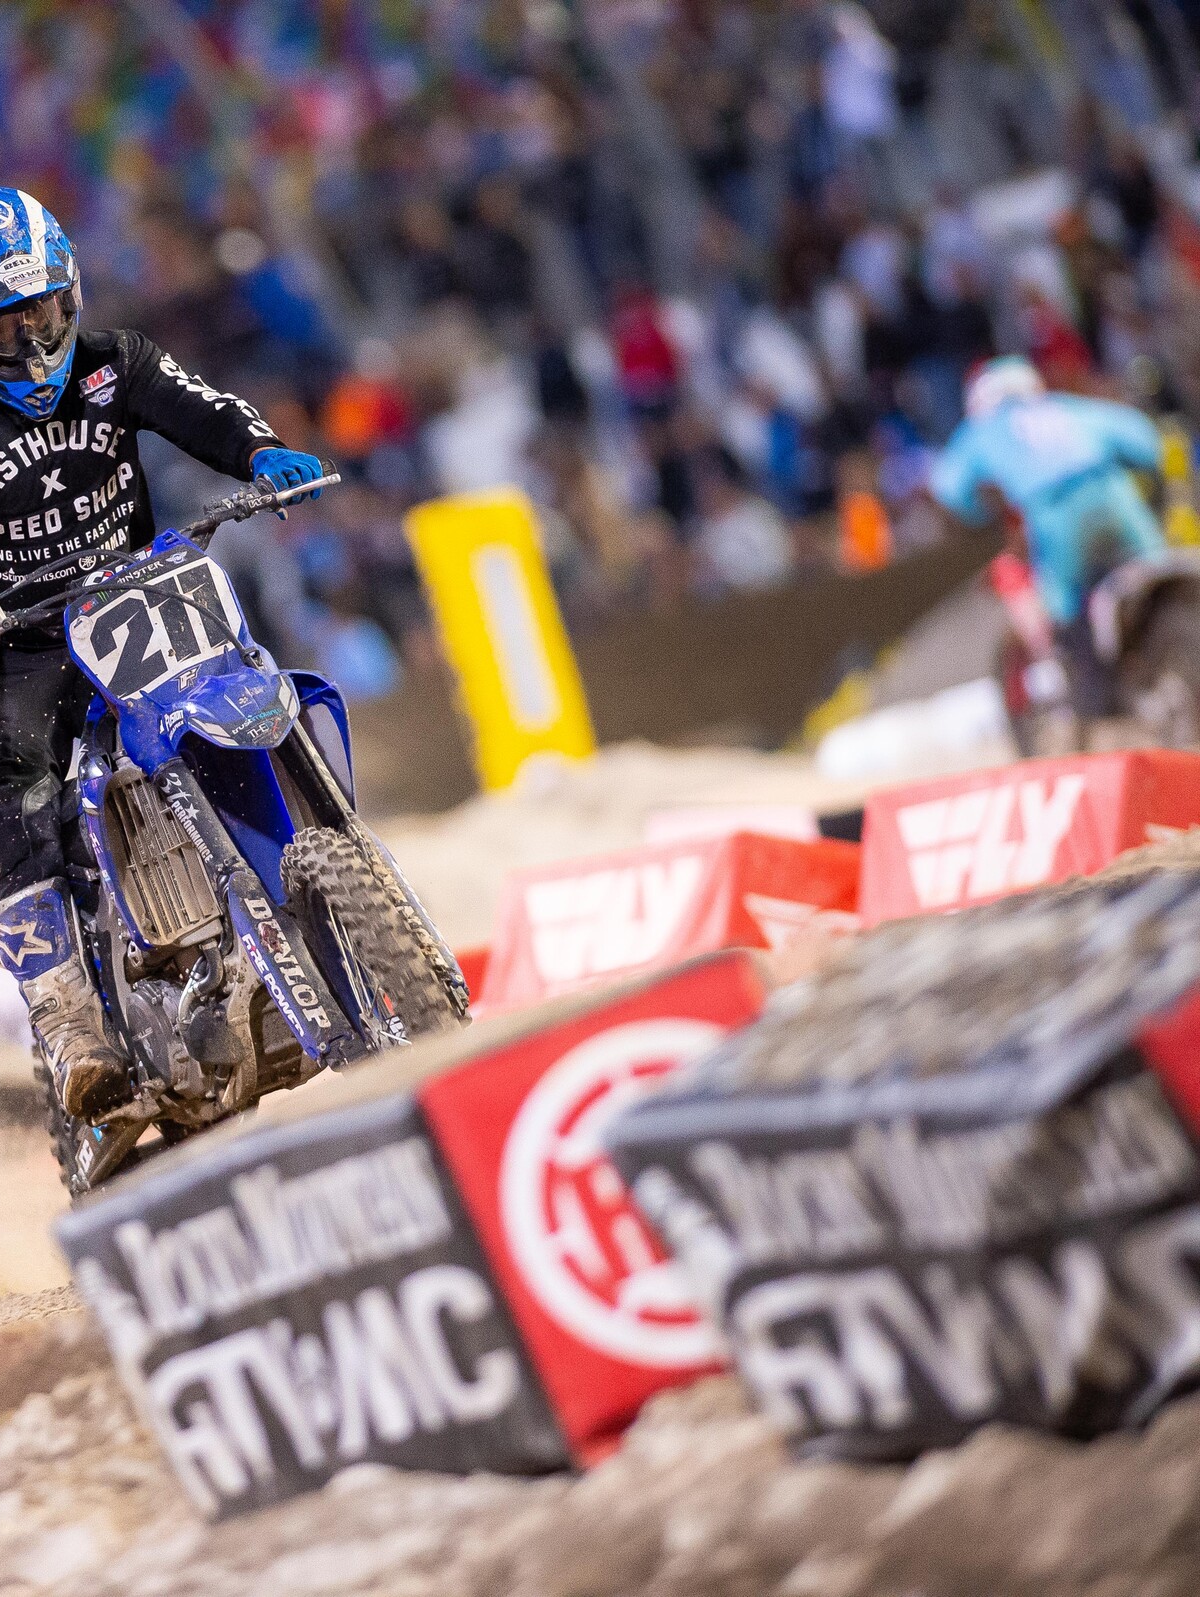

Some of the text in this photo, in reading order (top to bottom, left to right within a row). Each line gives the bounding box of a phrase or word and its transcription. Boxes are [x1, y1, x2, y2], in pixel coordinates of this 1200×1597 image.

[4, 257, 35, 271] BELL
[73, 461, 134, 522] SHOP
[19, 547, 51, 562] LIVE
[56, 536, 82, 555] THE
[85, 519, 111, 544] FAST
[112, 500, 135, 522] LIFE
[89, 562, 230, 700] 211
[171, 800, 214, 864] PERFORMANCE
[896, 774, 1085, 910] FLY
[243, 897, 332, 1029] DUNLOP
